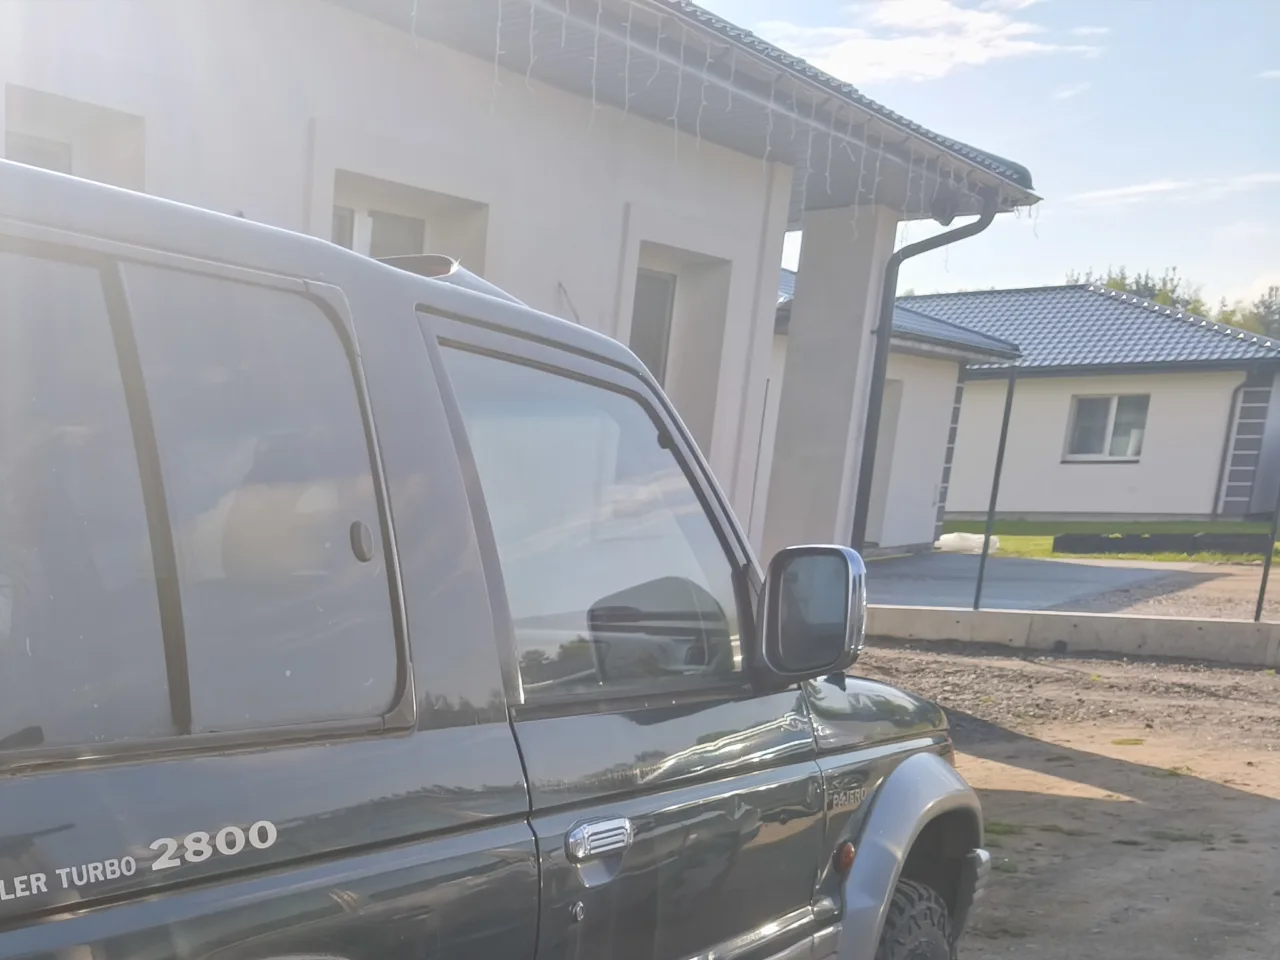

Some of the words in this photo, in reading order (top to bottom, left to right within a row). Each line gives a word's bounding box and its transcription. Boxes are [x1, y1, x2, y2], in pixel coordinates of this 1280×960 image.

[832, 787, 868, 810] PAJERO
[55, 854, 137, 890] TURBO
[149, 820, 278, 871] 2800
